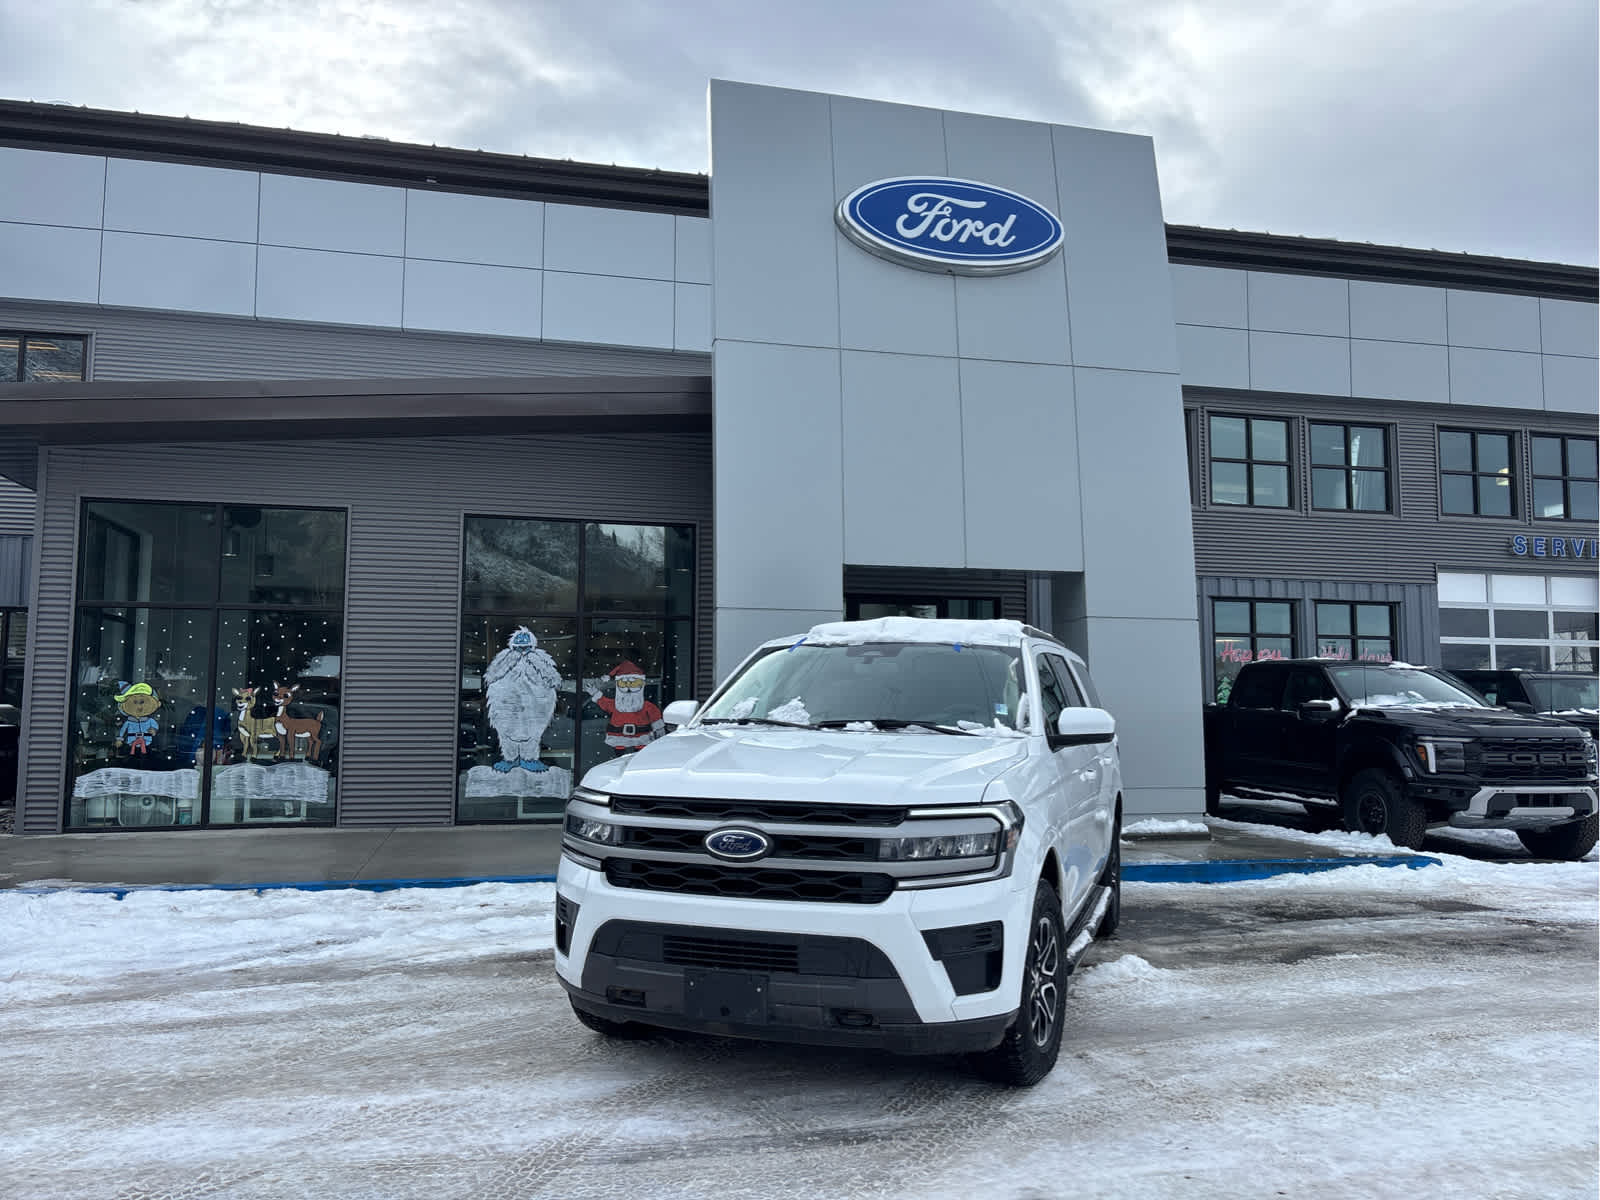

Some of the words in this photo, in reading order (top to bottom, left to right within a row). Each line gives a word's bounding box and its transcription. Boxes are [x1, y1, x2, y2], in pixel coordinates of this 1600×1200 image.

[895, 192, 1017, 248] Ford
[1512, 534, 1597, 559] SERVI
[719, 834, 753, 851] Ford
